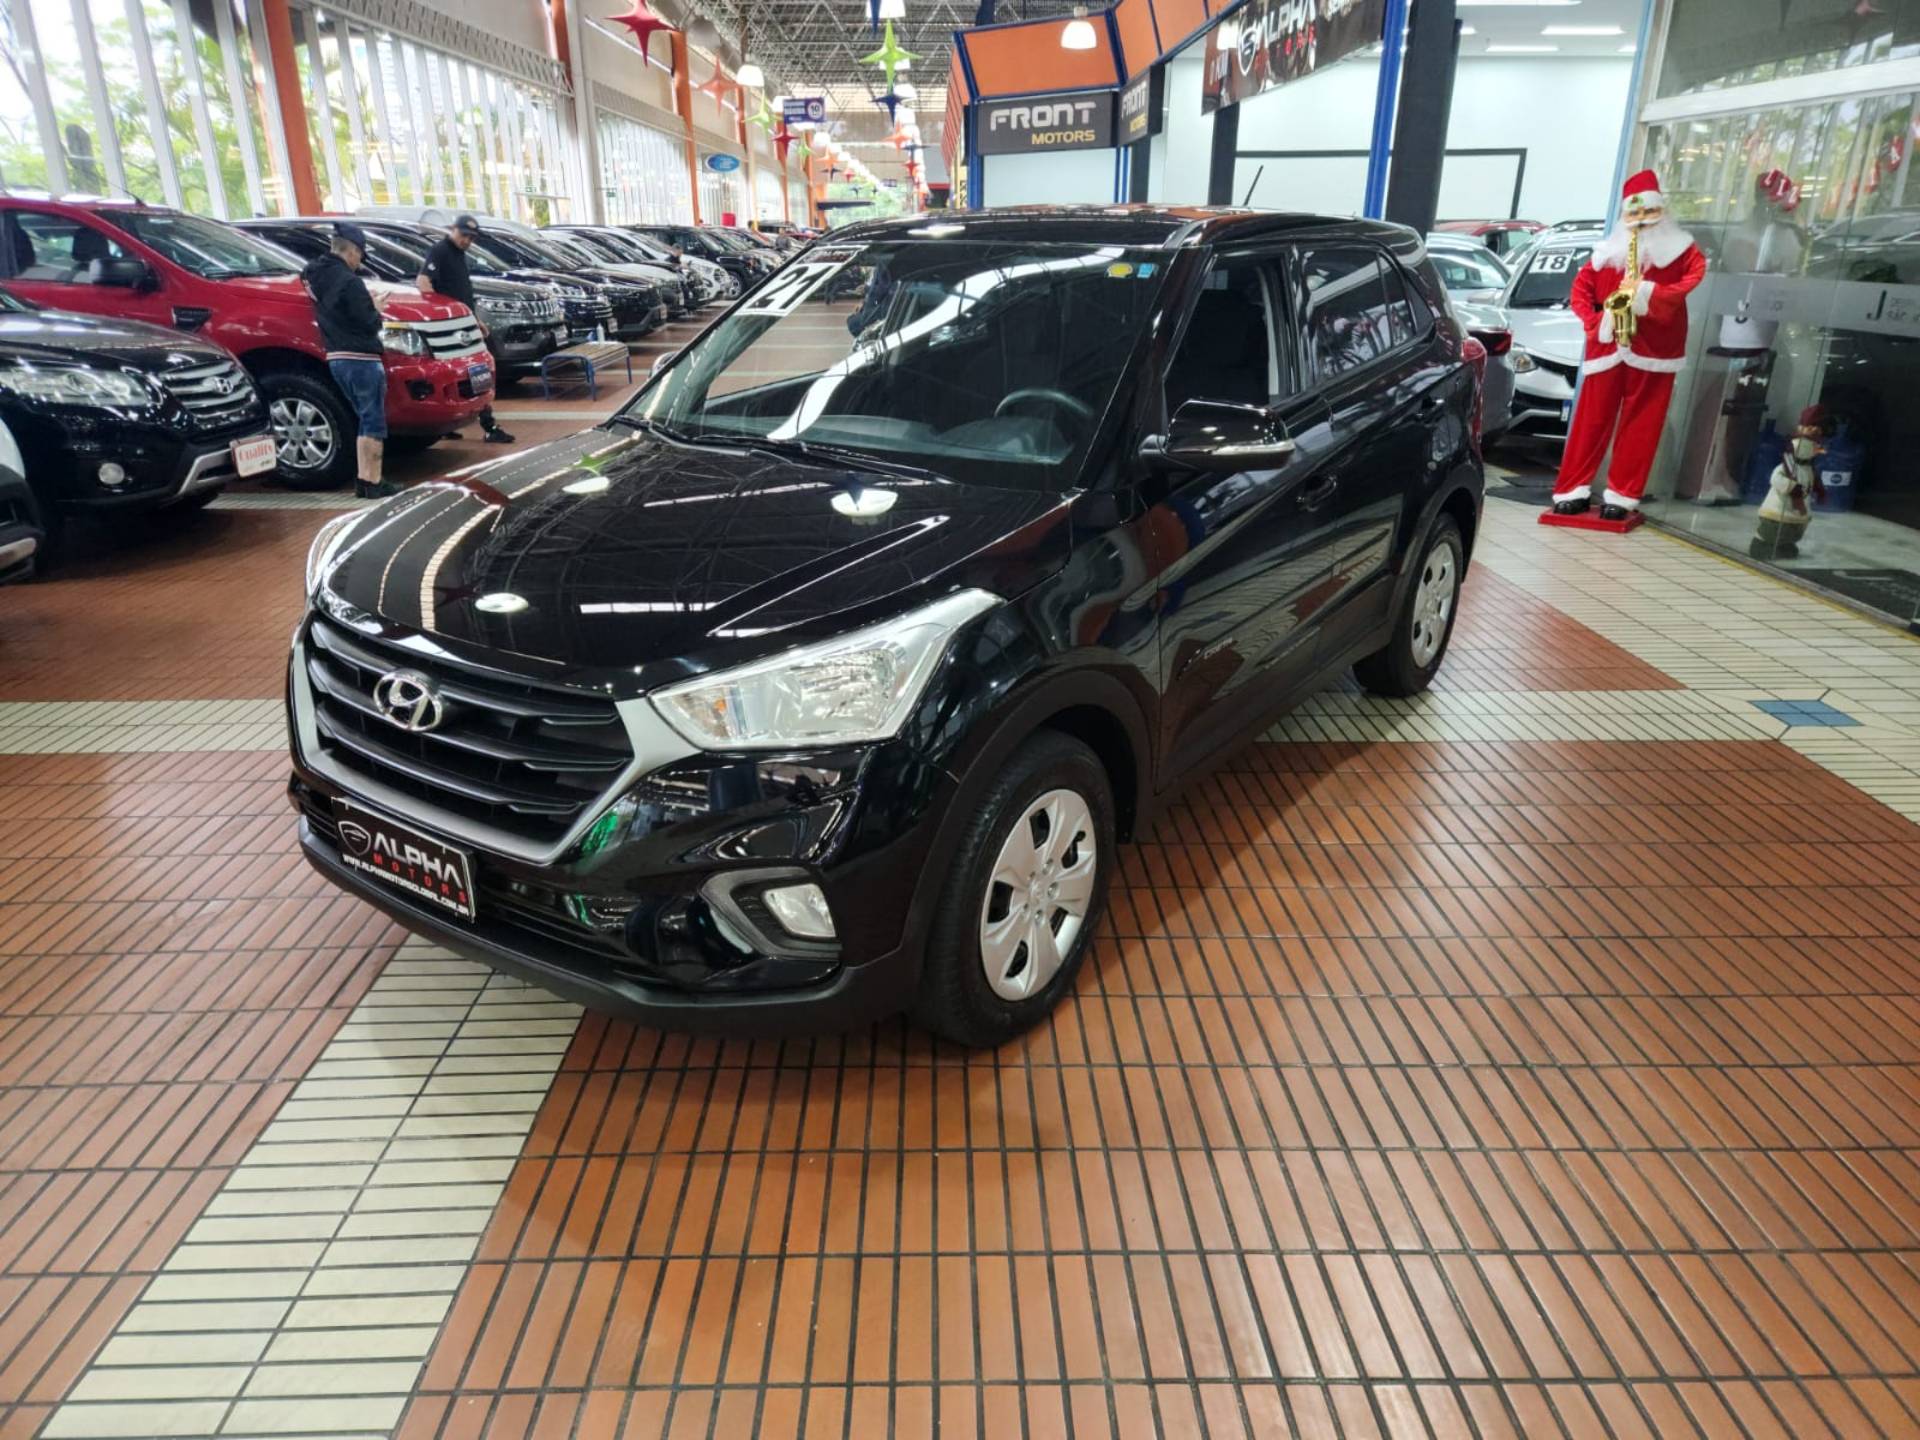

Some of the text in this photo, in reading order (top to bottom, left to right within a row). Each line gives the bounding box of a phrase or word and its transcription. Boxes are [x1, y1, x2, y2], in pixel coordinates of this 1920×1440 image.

[1254, 0, 1317, 51] ALPHA
[990, 101, 1096, 132] FRONT
[1031, 129, 1096, 145] MOTORS
[1536, 255, 1567, 270] 18
[745, 265, 834, 310] 21
[373, 852, 468, 904] MOTORS
[374, 832, 463, 888] ALPHA
